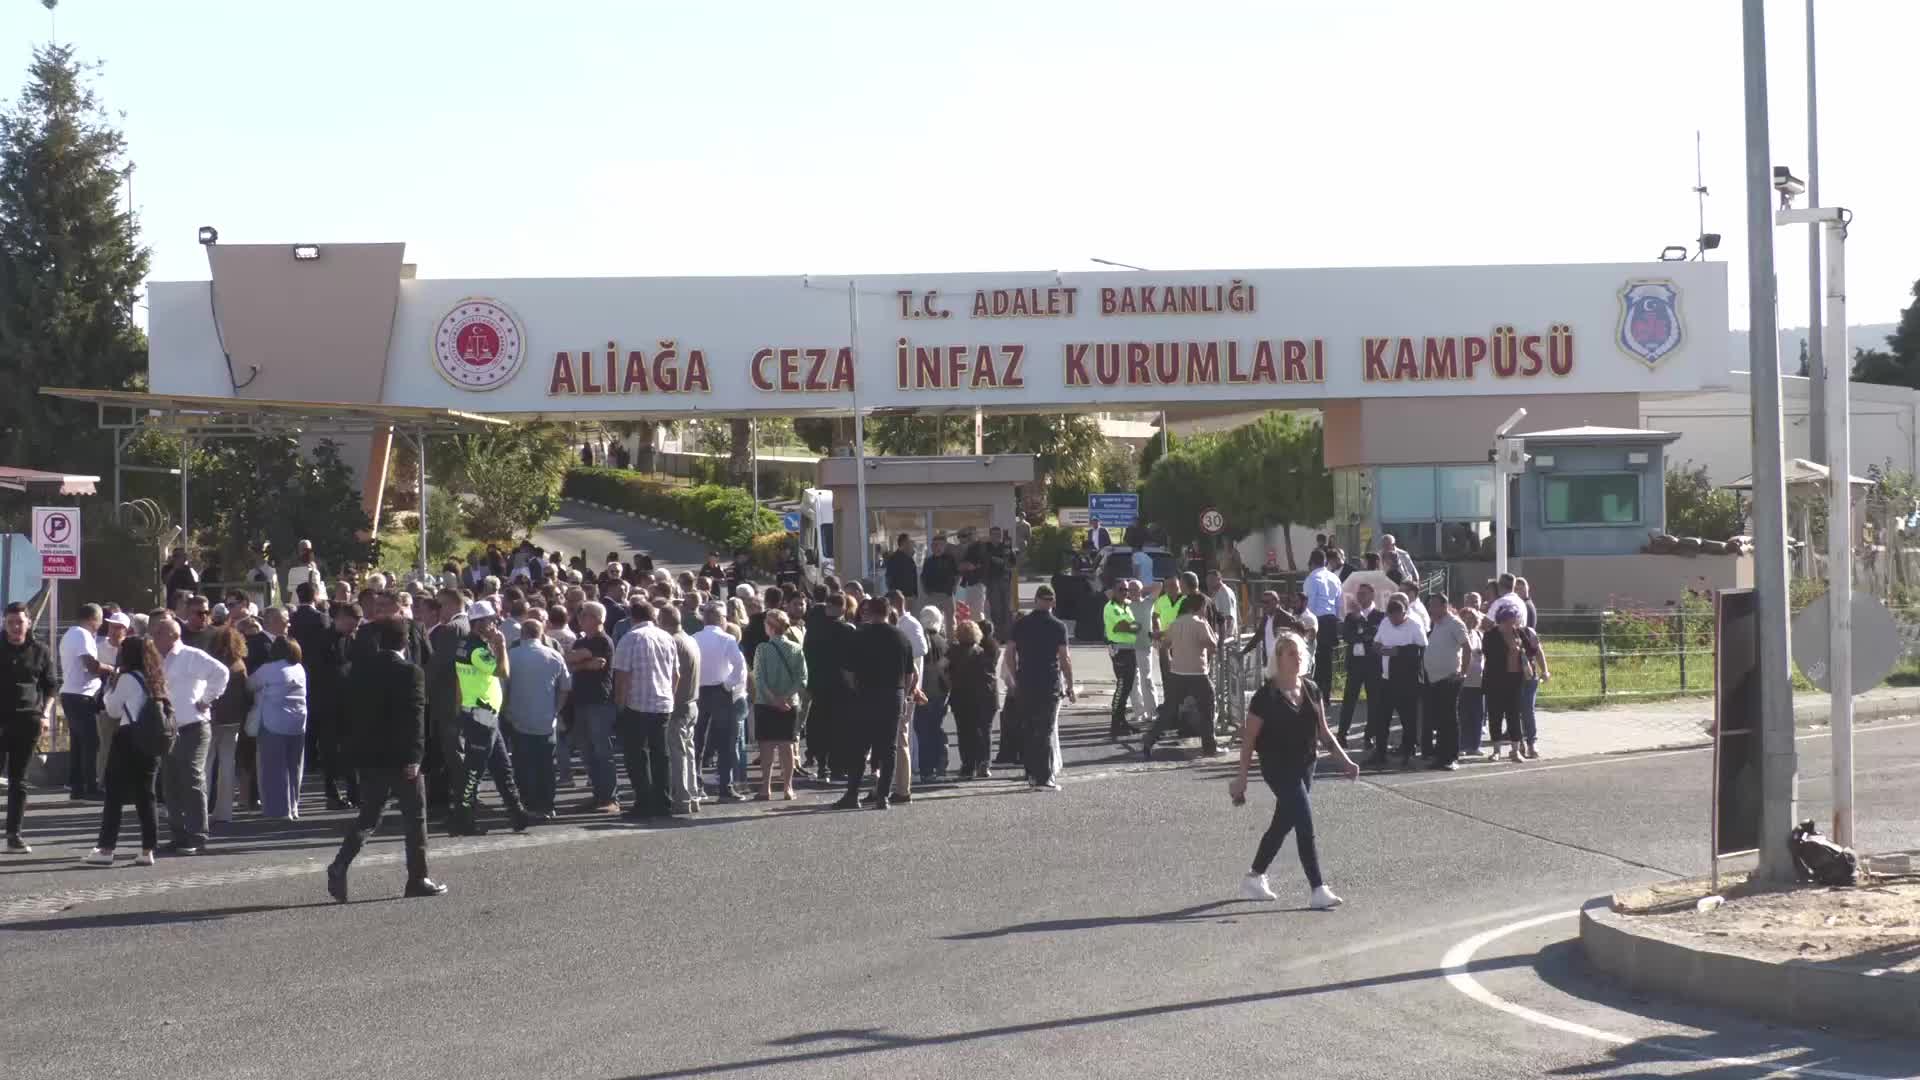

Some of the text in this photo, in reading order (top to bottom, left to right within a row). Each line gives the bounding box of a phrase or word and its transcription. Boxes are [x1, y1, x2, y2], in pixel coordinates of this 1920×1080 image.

[897, 280, 1255, 318] T.C. ADALET BAKANLIĞI
[549, 340, 712, 393] ALİAĞA
[750, 347, 855, 391] CEZA
[897, 337, 1025, 389] İNFAZ
[1065, 340, 1325, 387] KURUMLARI
[1363, 325, 1574, 382] KAMPÜSÜ
[1204, 514, 1221, 528] 30
